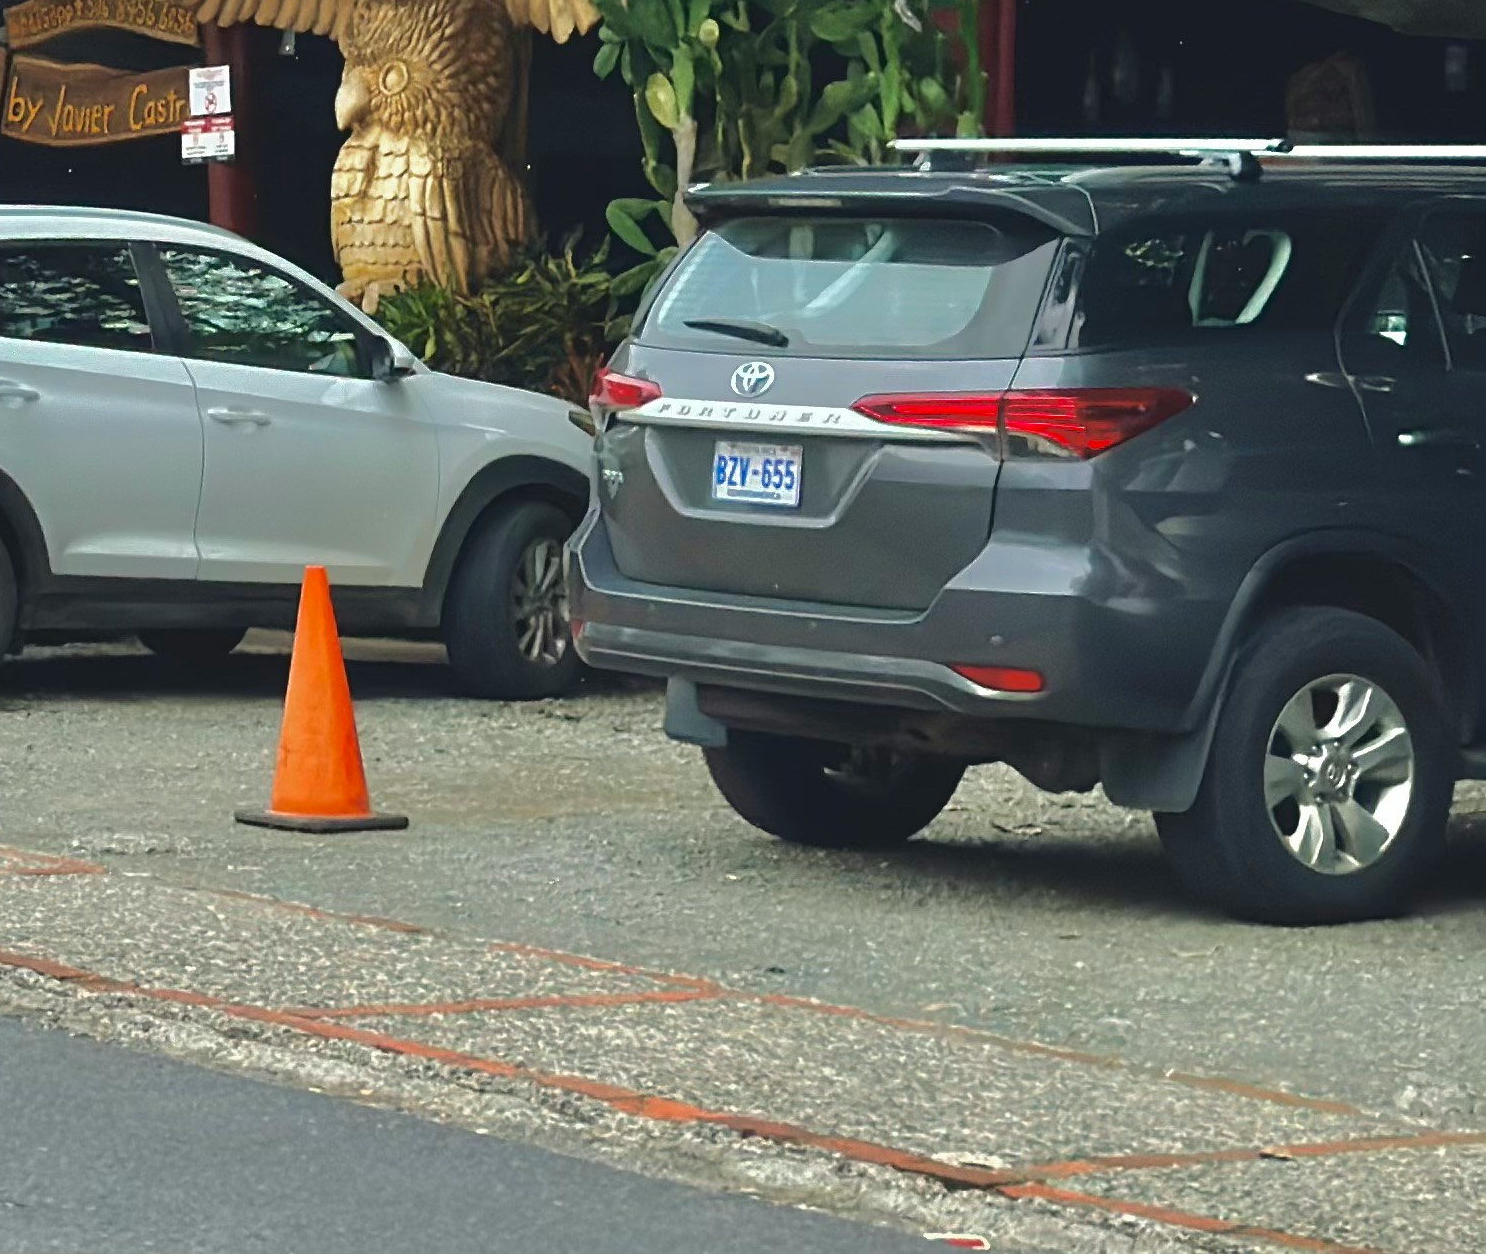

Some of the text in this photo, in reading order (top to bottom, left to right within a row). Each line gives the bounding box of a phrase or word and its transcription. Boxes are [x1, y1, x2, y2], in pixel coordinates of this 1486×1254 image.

[9, 75, 190, 137] by Javier Castr
[658, 404, 842, 425] FORTUNER
[716, 455, 795, 490] BZV-655
